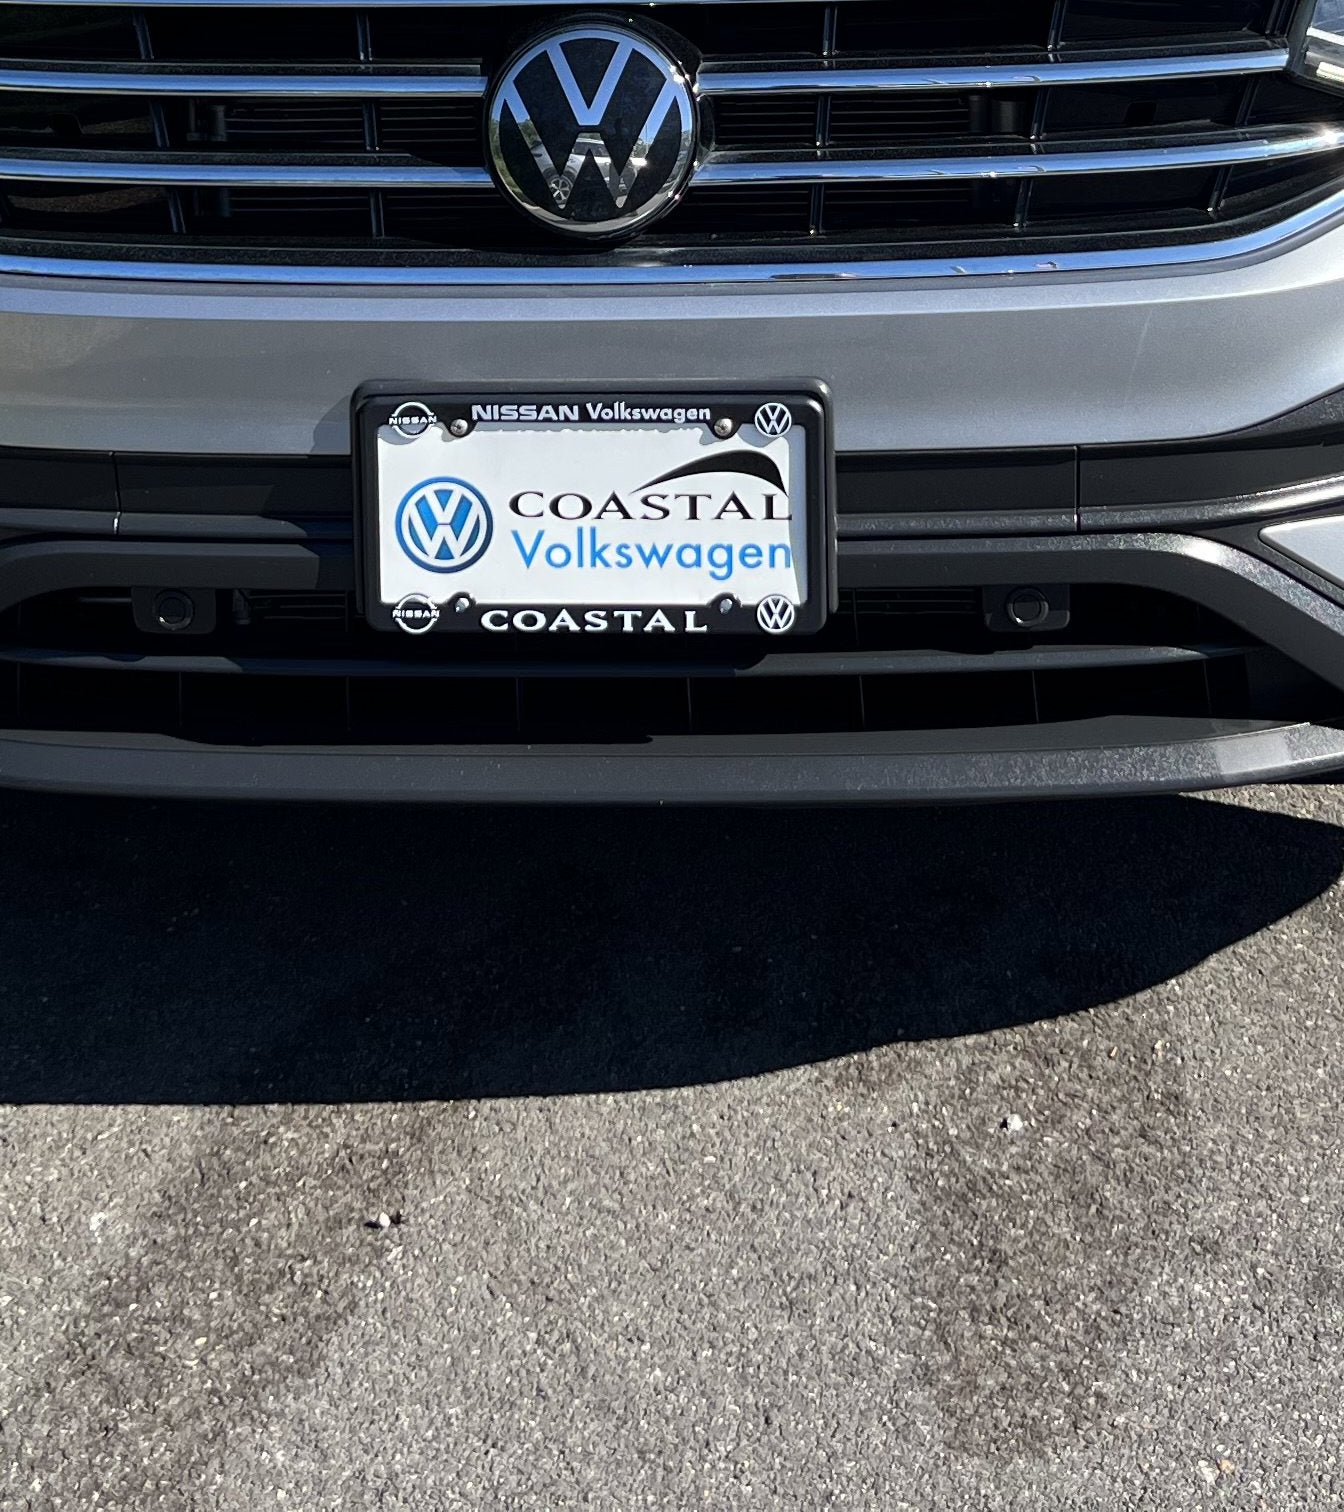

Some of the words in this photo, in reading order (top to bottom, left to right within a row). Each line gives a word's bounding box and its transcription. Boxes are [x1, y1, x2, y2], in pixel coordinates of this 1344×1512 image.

[388, 415, 438, 426] NISSAN
[471, 404, 580, 422] NISSAN
[585, 403, 710, 422] Volkswagen
[508, 491, 793, 521] COASTAL
[511, 525, 792, 581] Volkswagen
[392, 609, 440, 619] NISSAN
[480, 609, 708, 632] COASTAL
